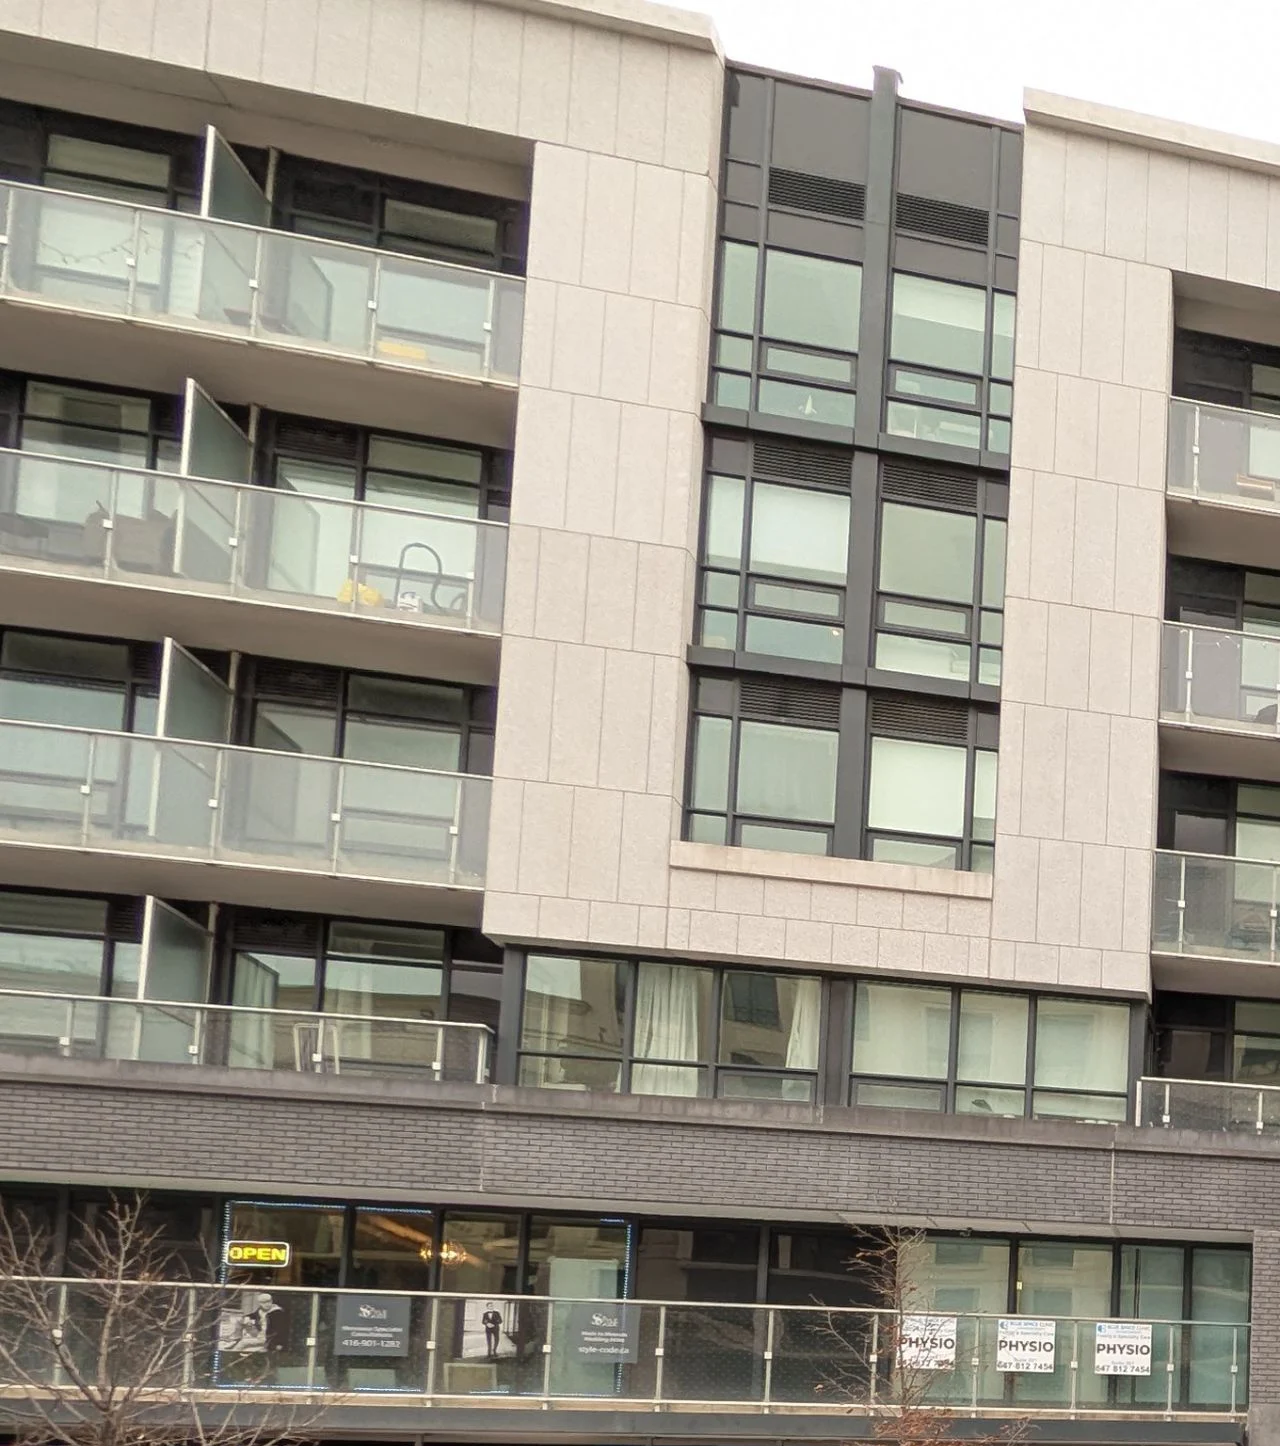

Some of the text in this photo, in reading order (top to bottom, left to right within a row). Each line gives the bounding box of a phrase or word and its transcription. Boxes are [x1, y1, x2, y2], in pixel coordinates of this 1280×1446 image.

[229, 1246, 286, 1261] OPEN
[899, 1336, 955, 1349] PHYSIO
[999, 1340, 1054, 1352] PHYSIO
[1097, 1343, 1150, 1355] PHYSIO
